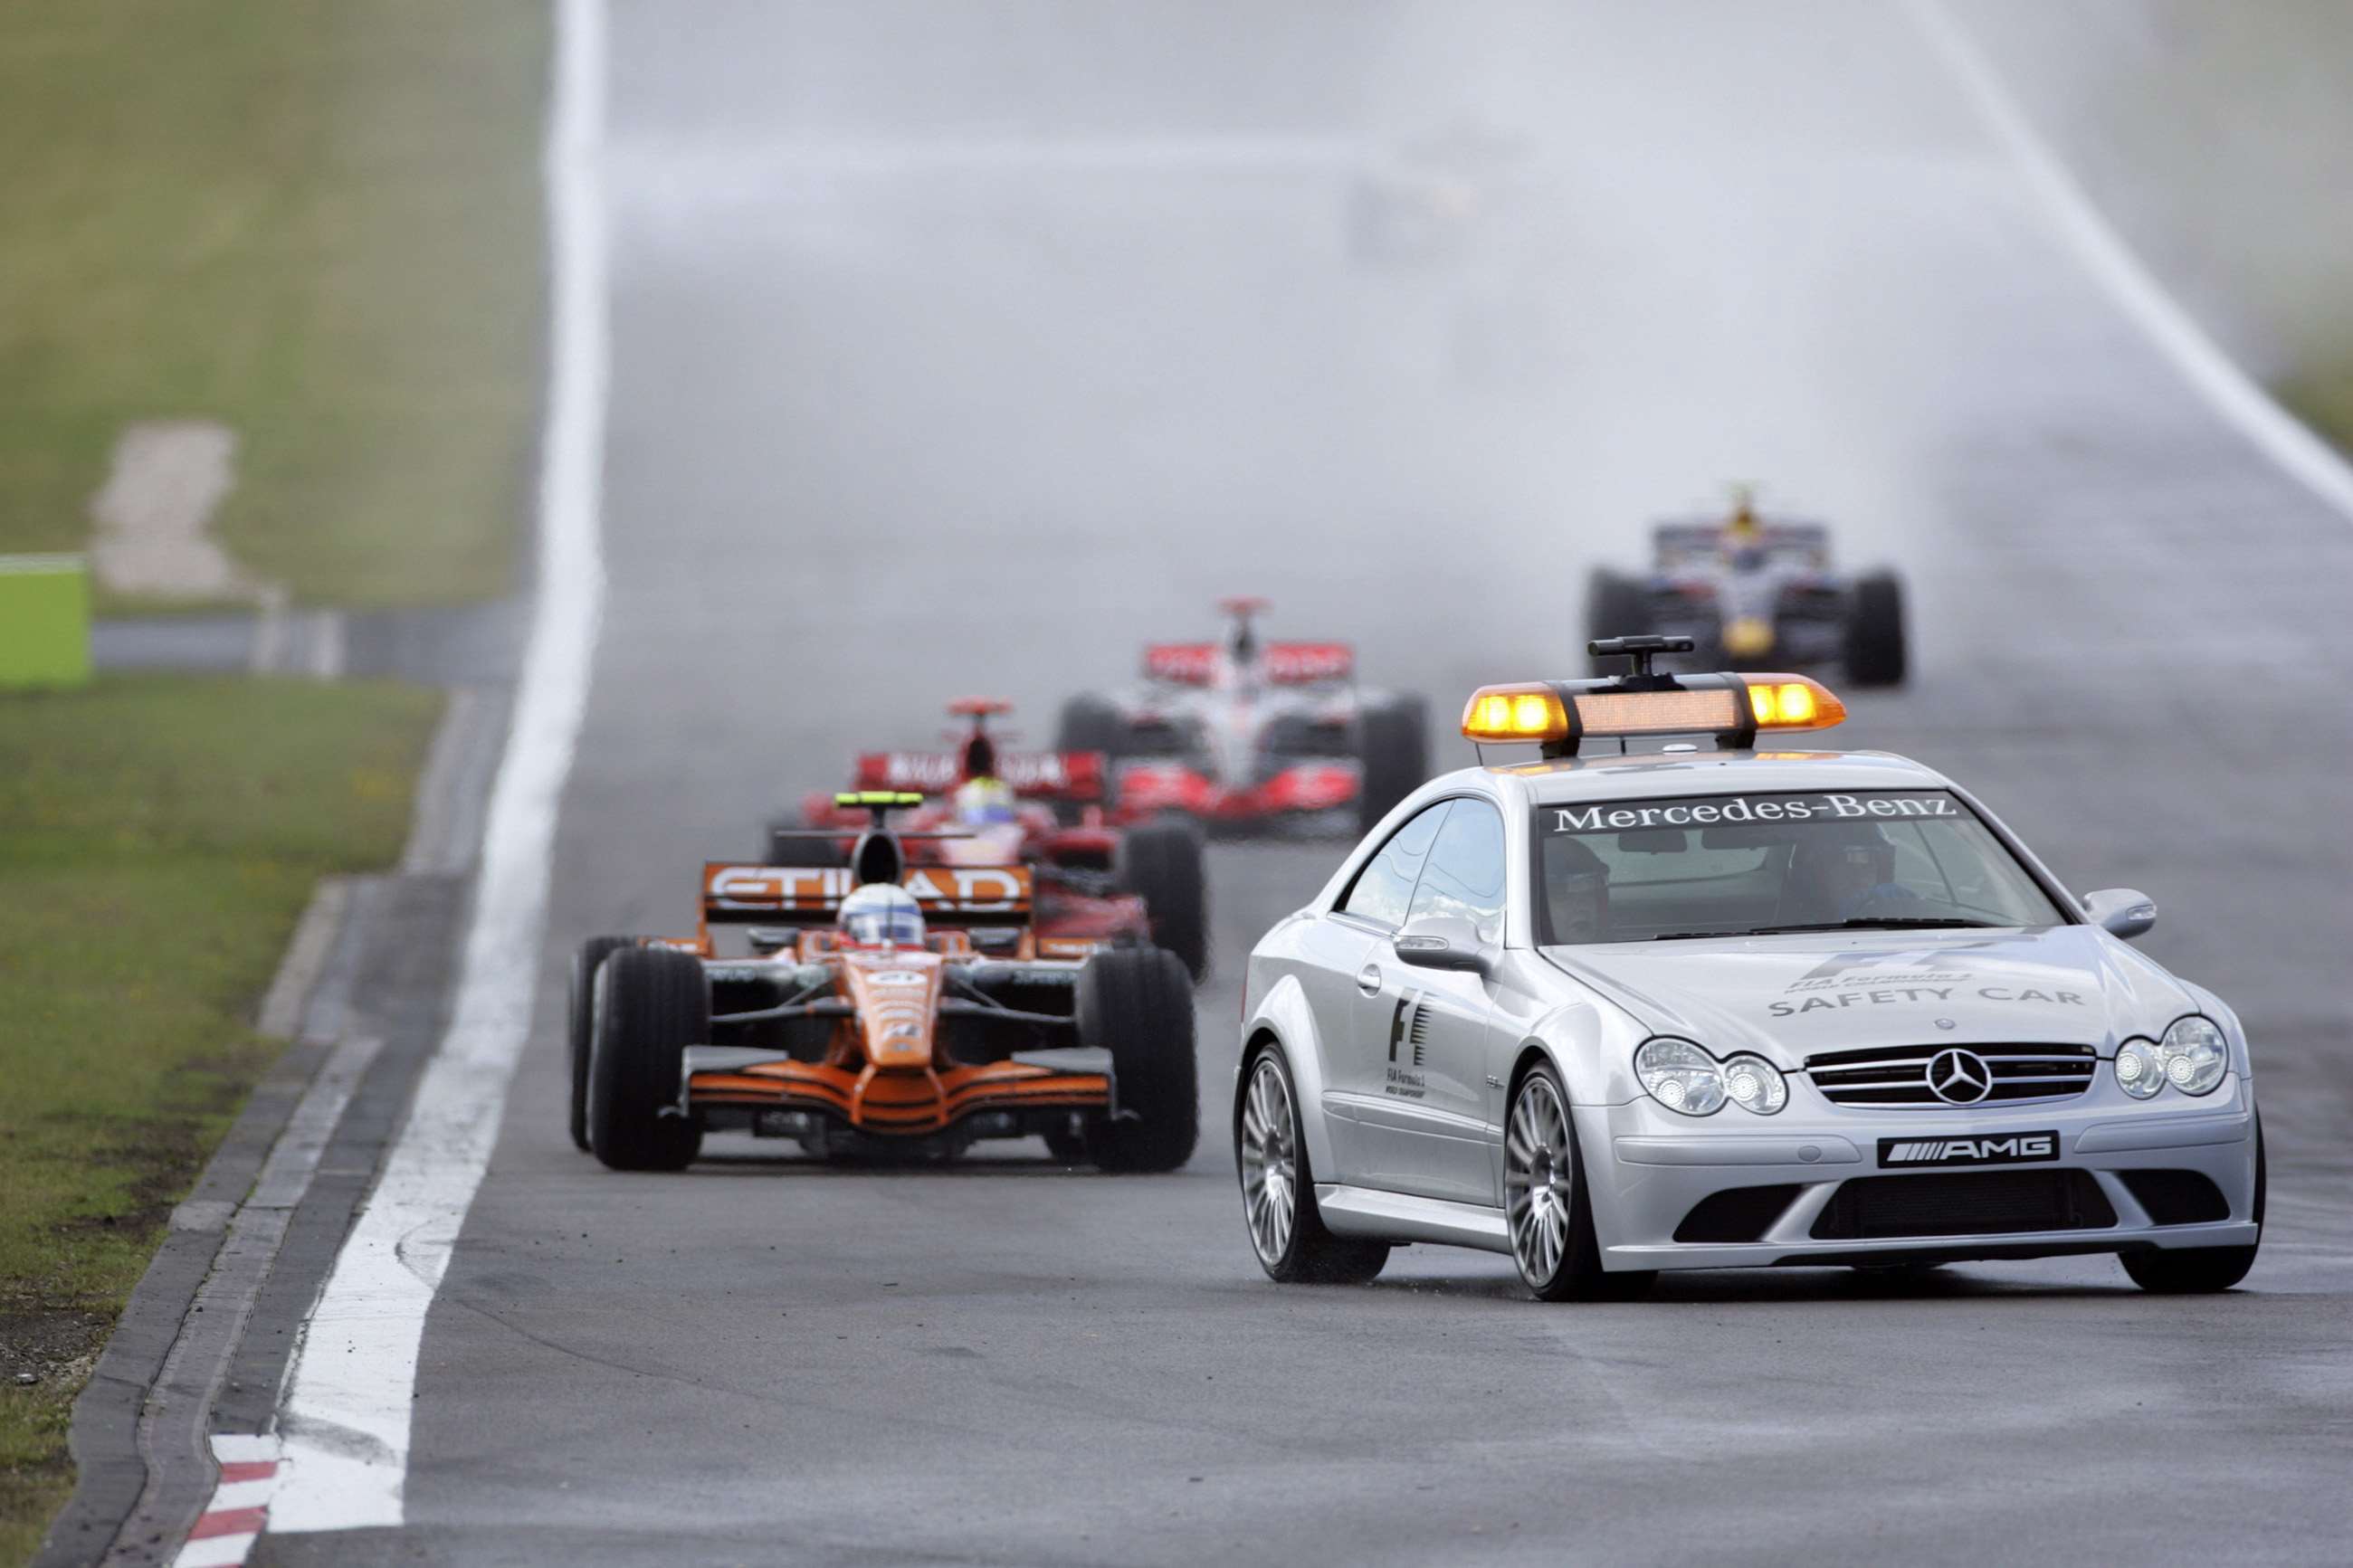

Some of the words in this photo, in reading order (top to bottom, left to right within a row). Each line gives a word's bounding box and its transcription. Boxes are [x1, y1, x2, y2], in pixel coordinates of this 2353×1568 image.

[1553, 794, 1958, 832] Mercedes-Benz
[1767, 988, 1954, 1017] SAFETY
[1977, 987, 2086, 1006] CAR
[1939, 1136, 2053, 1160] AMG
